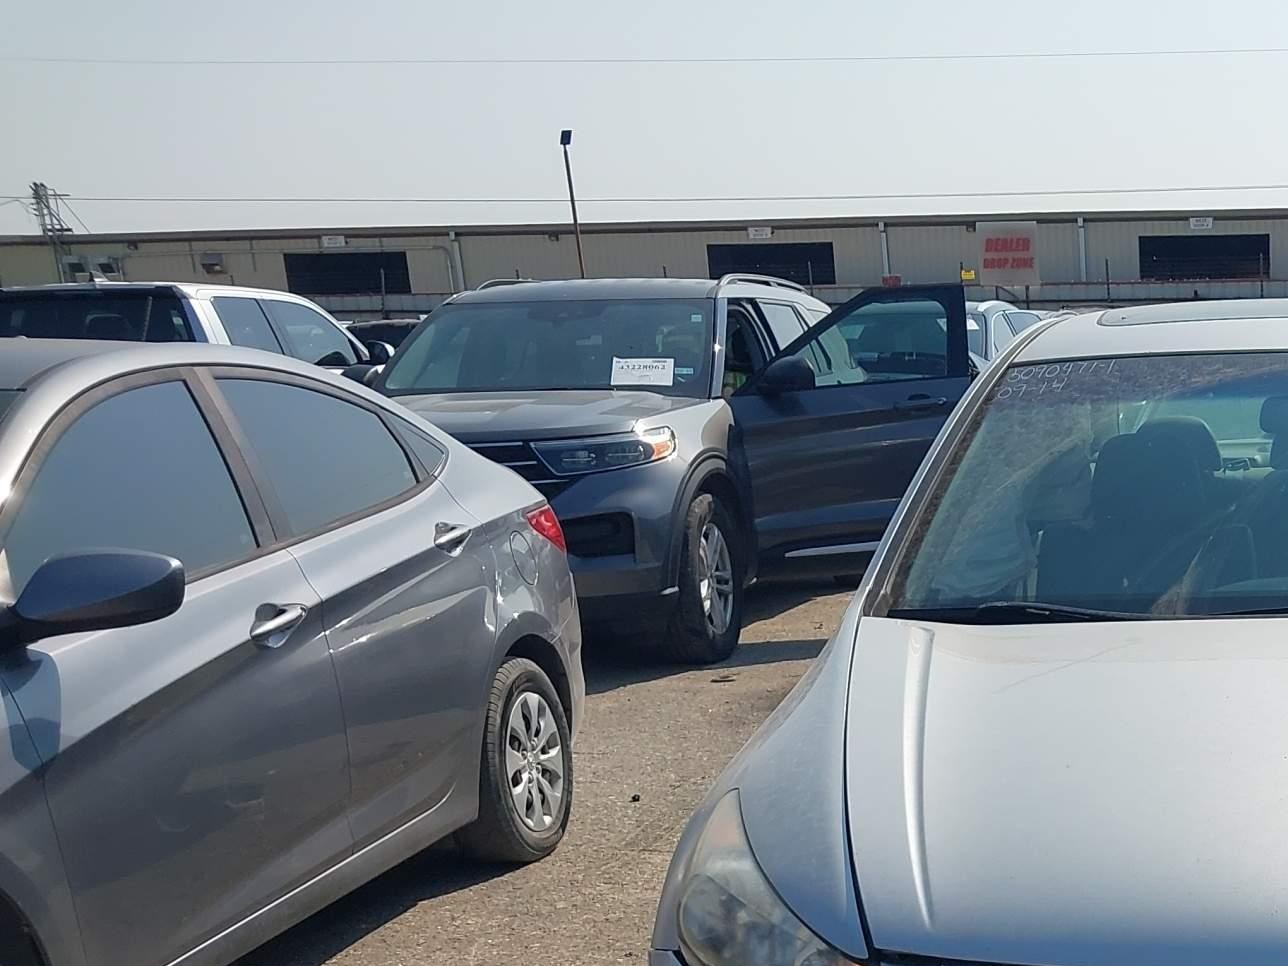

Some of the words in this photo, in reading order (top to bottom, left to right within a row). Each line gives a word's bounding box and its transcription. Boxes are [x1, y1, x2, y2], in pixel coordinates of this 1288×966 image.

[985, 238, 1030, 252] DEALER
[983, 258, 1010, 269] DROP
[1011, 257, 1034, 269] ZONE
